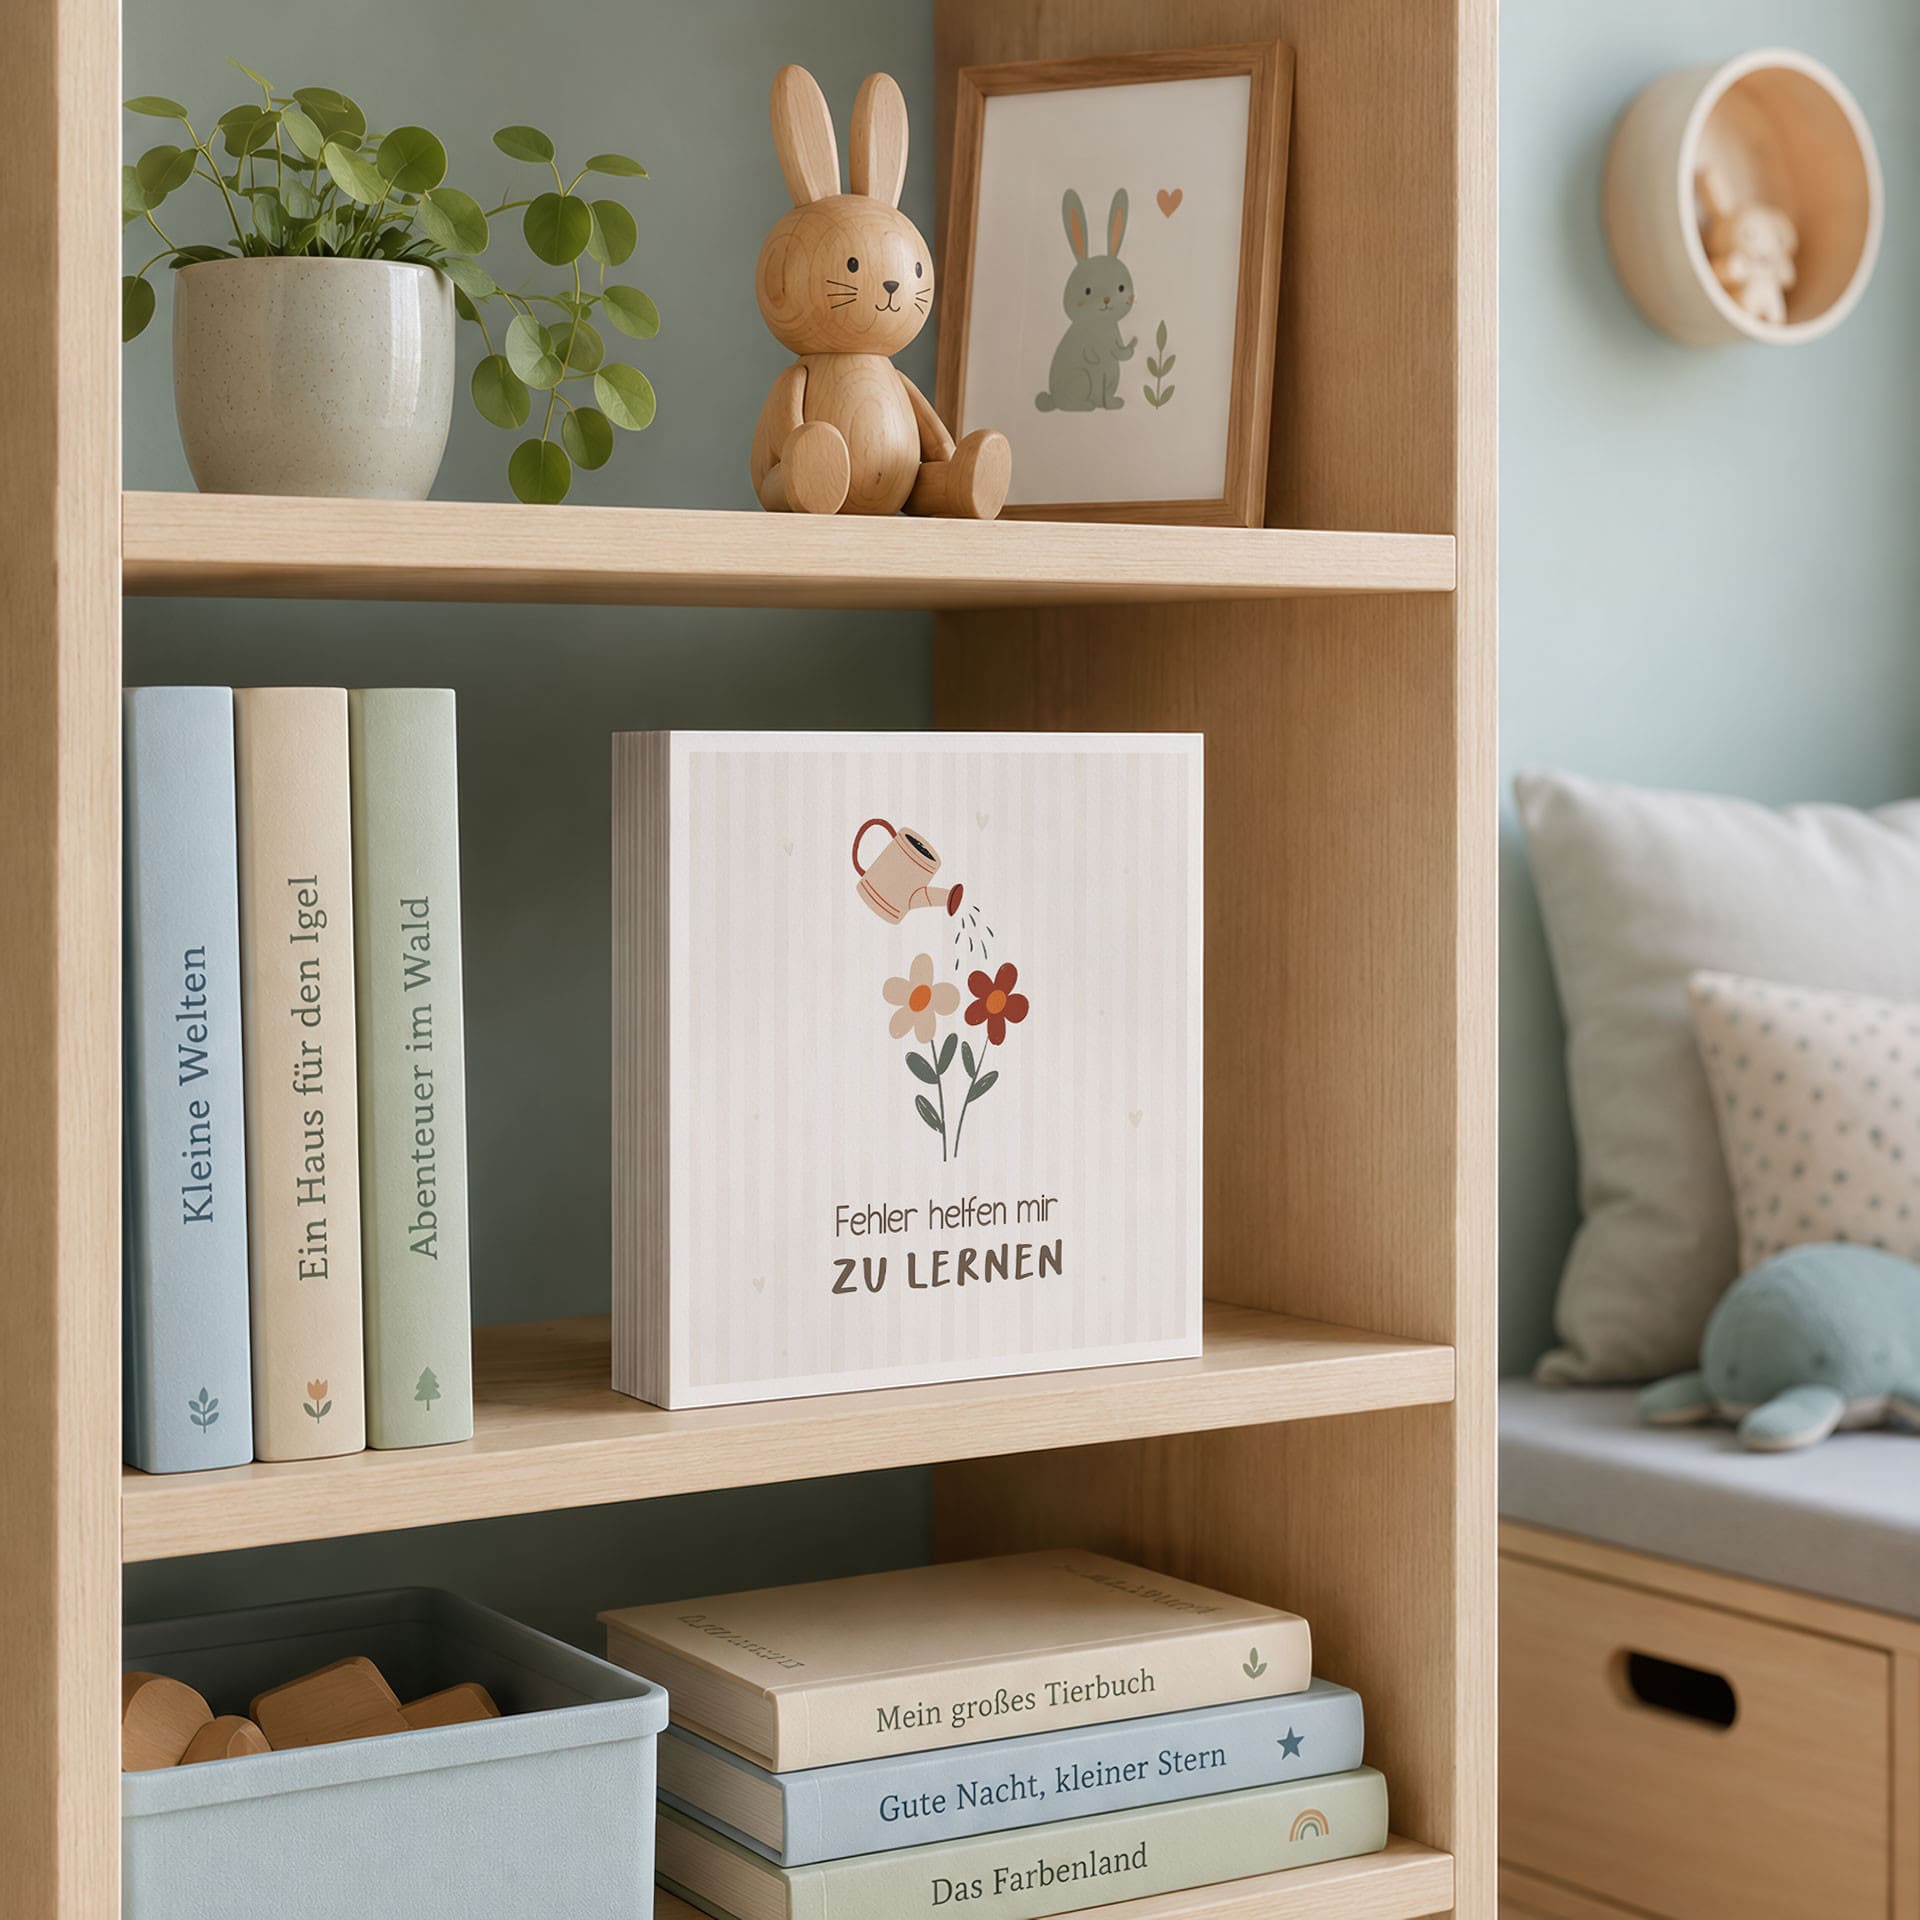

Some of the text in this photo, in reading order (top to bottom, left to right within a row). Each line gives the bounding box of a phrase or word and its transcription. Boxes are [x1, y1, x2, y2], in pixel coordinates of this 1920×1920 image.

[175, 945, 214, 1225] Kleine Welten
[287, 874, 329, 1282] Ein Haus für den Igel
[399, 895, 438, 1261] Abenteuer im Wald
[835, 1193, 1059, 1238] Fehler helfen mir
[831, 1238, 1063, 1295] ZU LERNEN
[876, 1667, 1156, 1733] Mein großes Tierbuch
[879, 1748, 1227, 1823] Gute Nacht, kleiner Stern
[930, 1840, 1149, 1907] Das Farbenland
